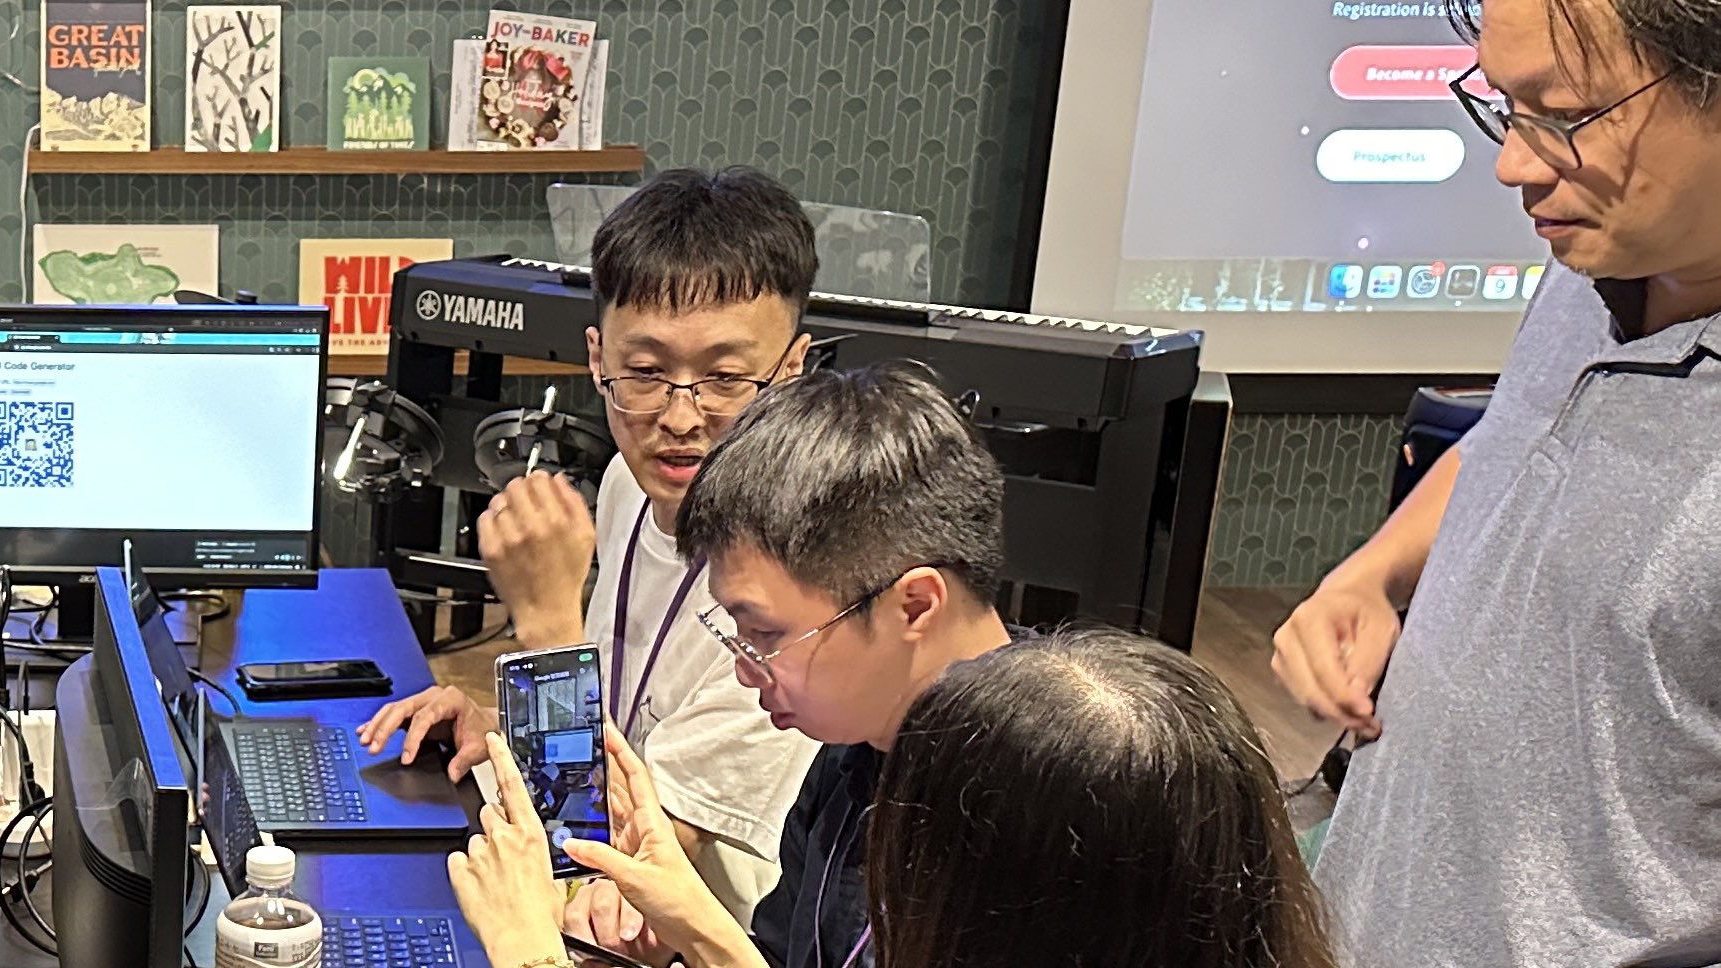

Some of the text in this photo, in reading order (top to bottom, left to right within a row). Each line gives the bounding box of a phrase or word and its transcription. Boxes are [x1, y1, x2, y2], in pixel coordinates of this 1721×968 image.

[1332, 2, 1419, 19] Registration
[1423, 3, 1436, 16] is
[48, 24, 145, 46] GREAT
[490, 21, 523, 38] JOY
[531, 26, 590, 47] BAKER
[49, 47, 142, 69] BASIN
[1366, 67, 1424, 81] Become
[1426, 70, 1435, 80] a
[1353, 150, 1426, 163] Prospectus
[324, 256, 414, 294] WIL
[1495, 278, 1506, 293] 9
[442, 293, 524, 331] YAMAHA
[4, 361, 28, 370] Code
[30, 361, 75, 371] Generator
